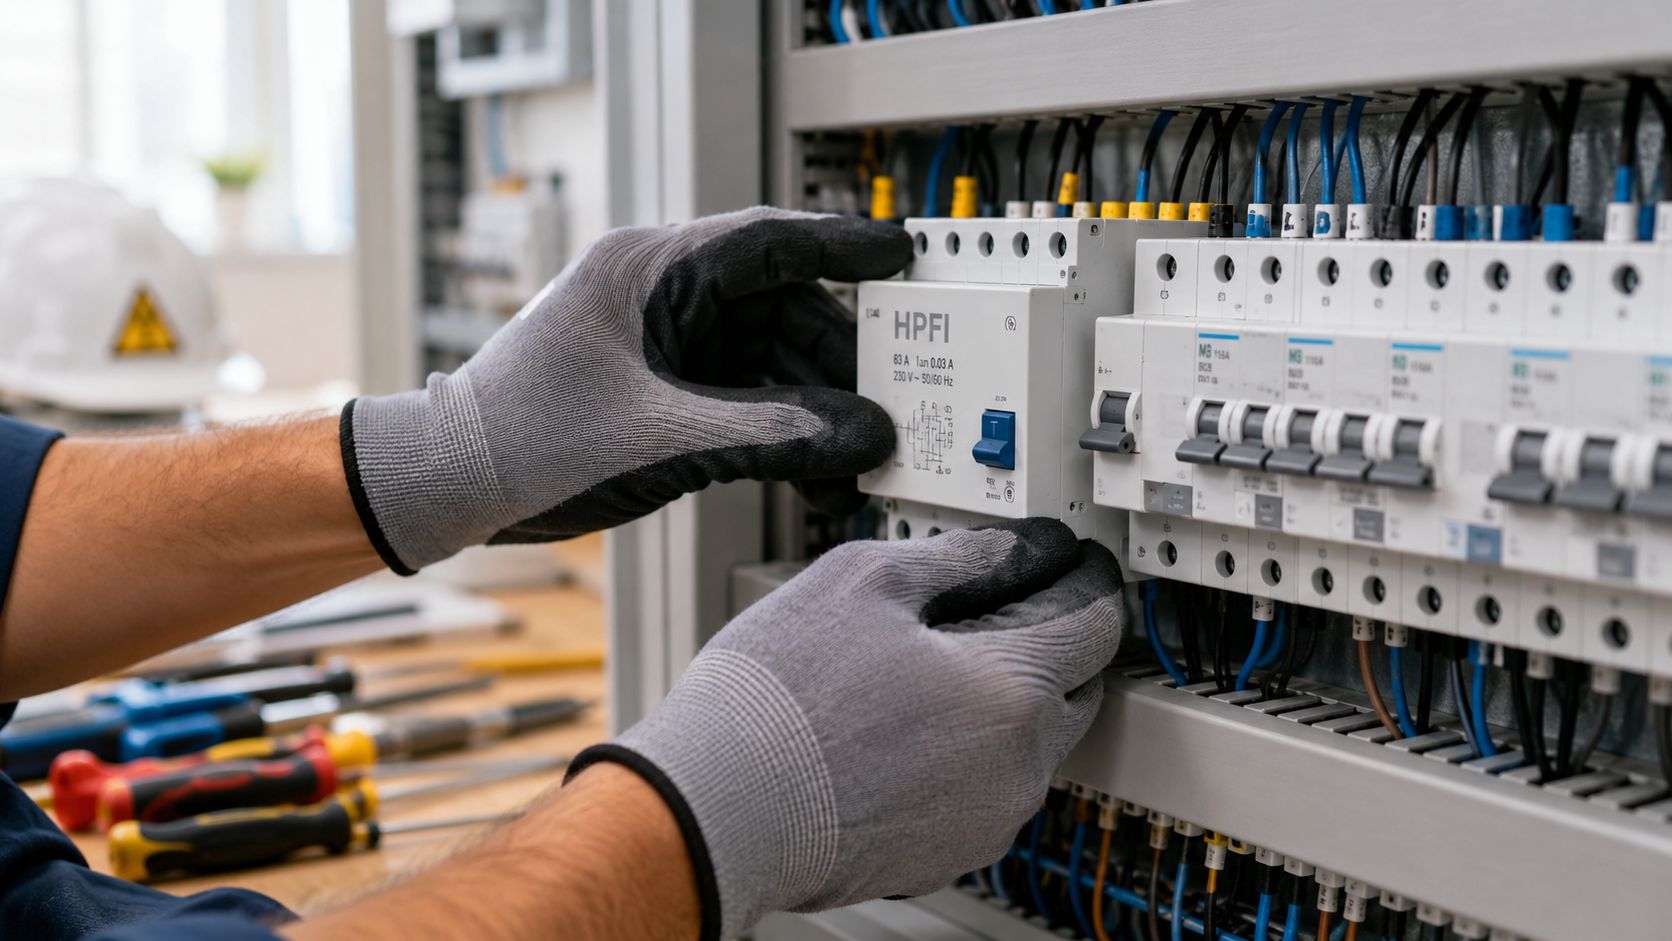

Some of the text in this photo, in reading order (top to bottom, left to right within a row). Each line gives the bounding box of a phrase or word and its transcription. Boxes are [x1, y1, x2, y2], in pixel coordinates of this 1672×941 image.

[894, 310, 949, 343] HPFI
[893, 353, 903, 366] 63
[904, 354, 910, 366] A
[930, 357, 947, 370] 0.03
[948, 358, 954, 370] A
[893, 370, 907, 382] 230
[907, 371, 914, 383] V
[921, 372, 943, 386] 50/60
[944, 375, 954, 387] Hz
